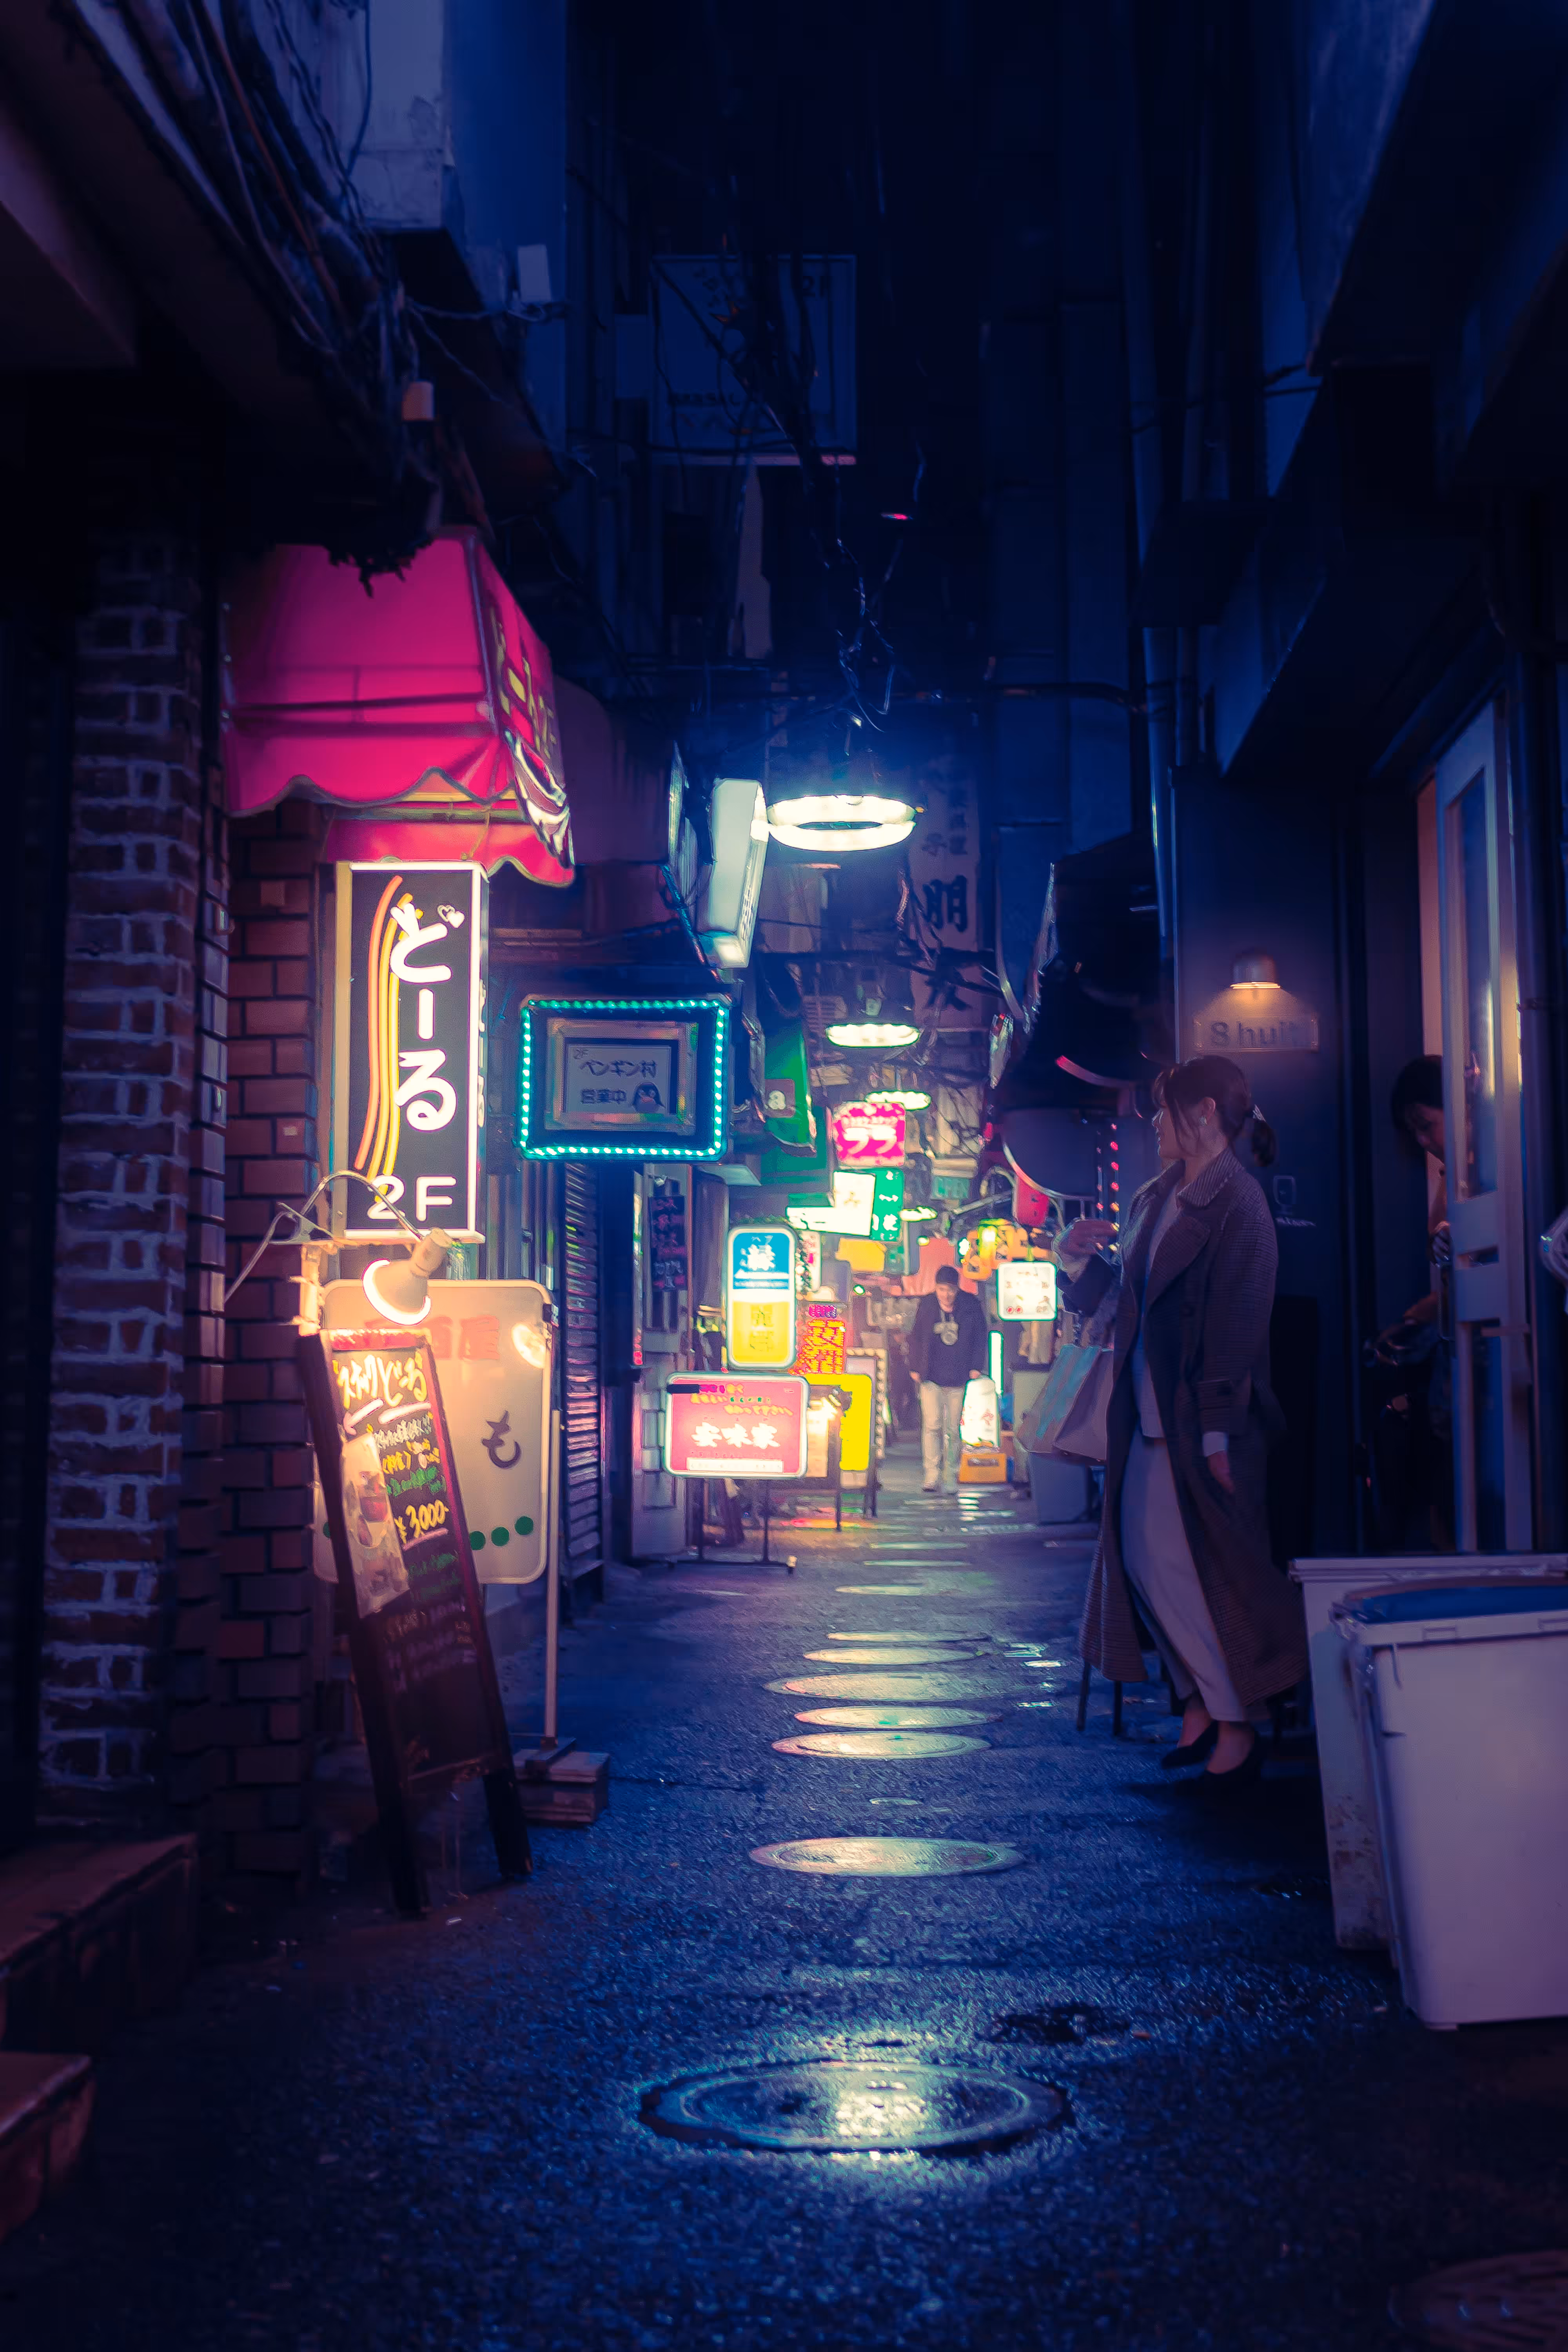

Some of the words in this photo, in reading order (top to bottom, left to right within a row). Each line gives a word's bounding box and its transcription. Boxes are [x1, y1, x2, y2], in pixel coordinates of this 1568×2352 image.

[390, 902, 465, 1131] どーる
[367, 1175, 457, 1222] 2F
